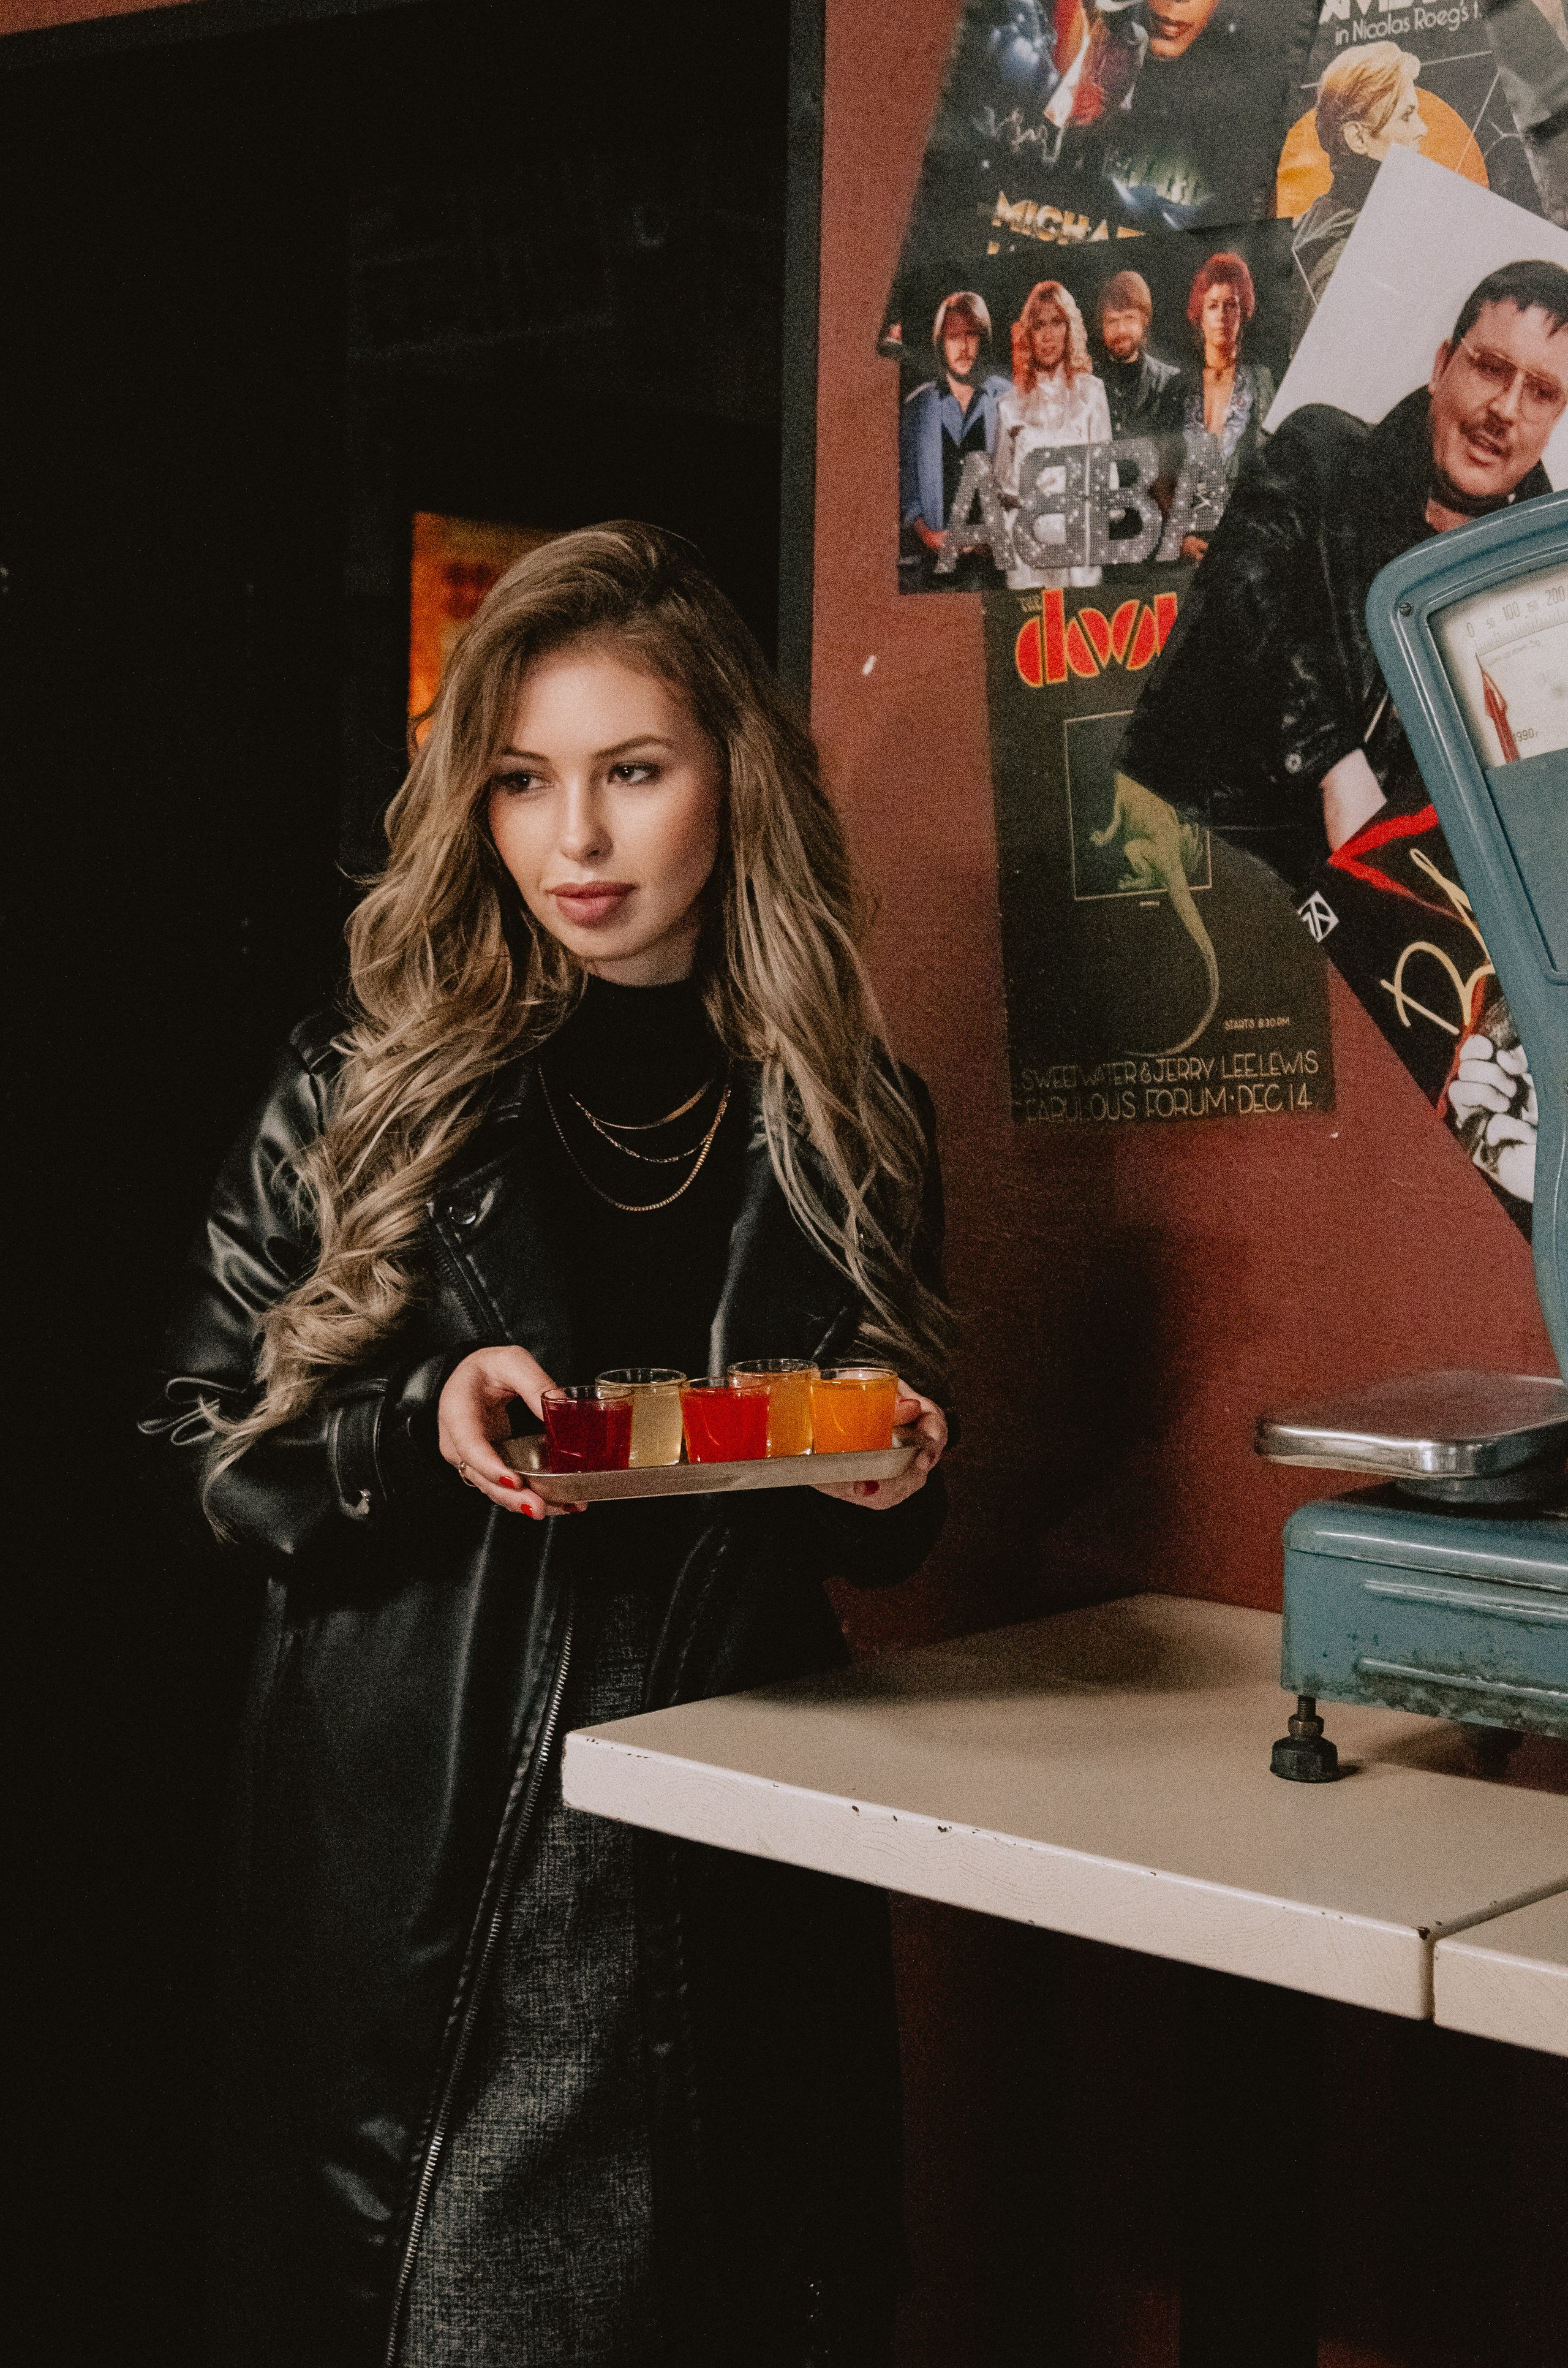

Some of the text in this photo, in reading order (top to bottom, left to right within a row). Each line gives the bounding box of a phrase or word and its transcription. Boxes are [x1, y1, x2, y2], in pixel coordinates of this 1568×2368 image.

[1335, 26, 1348, 45] in
[1352, 12, 1410, 42] Nicolas
[1414, 0, 1469, 31] Roeg's
[933, 431, 1228, 575] ABBA
[1466, 622, 1475, 638] 0
[1502, 602, 1521, 621] 100
[1545, 586, 1566, 606] 200
[1153, 1057, 1215, 1083] JERRY
[1146, 1086, 1226, 1118] FORUM
[1290, 1083, 1313, 1111] 14
